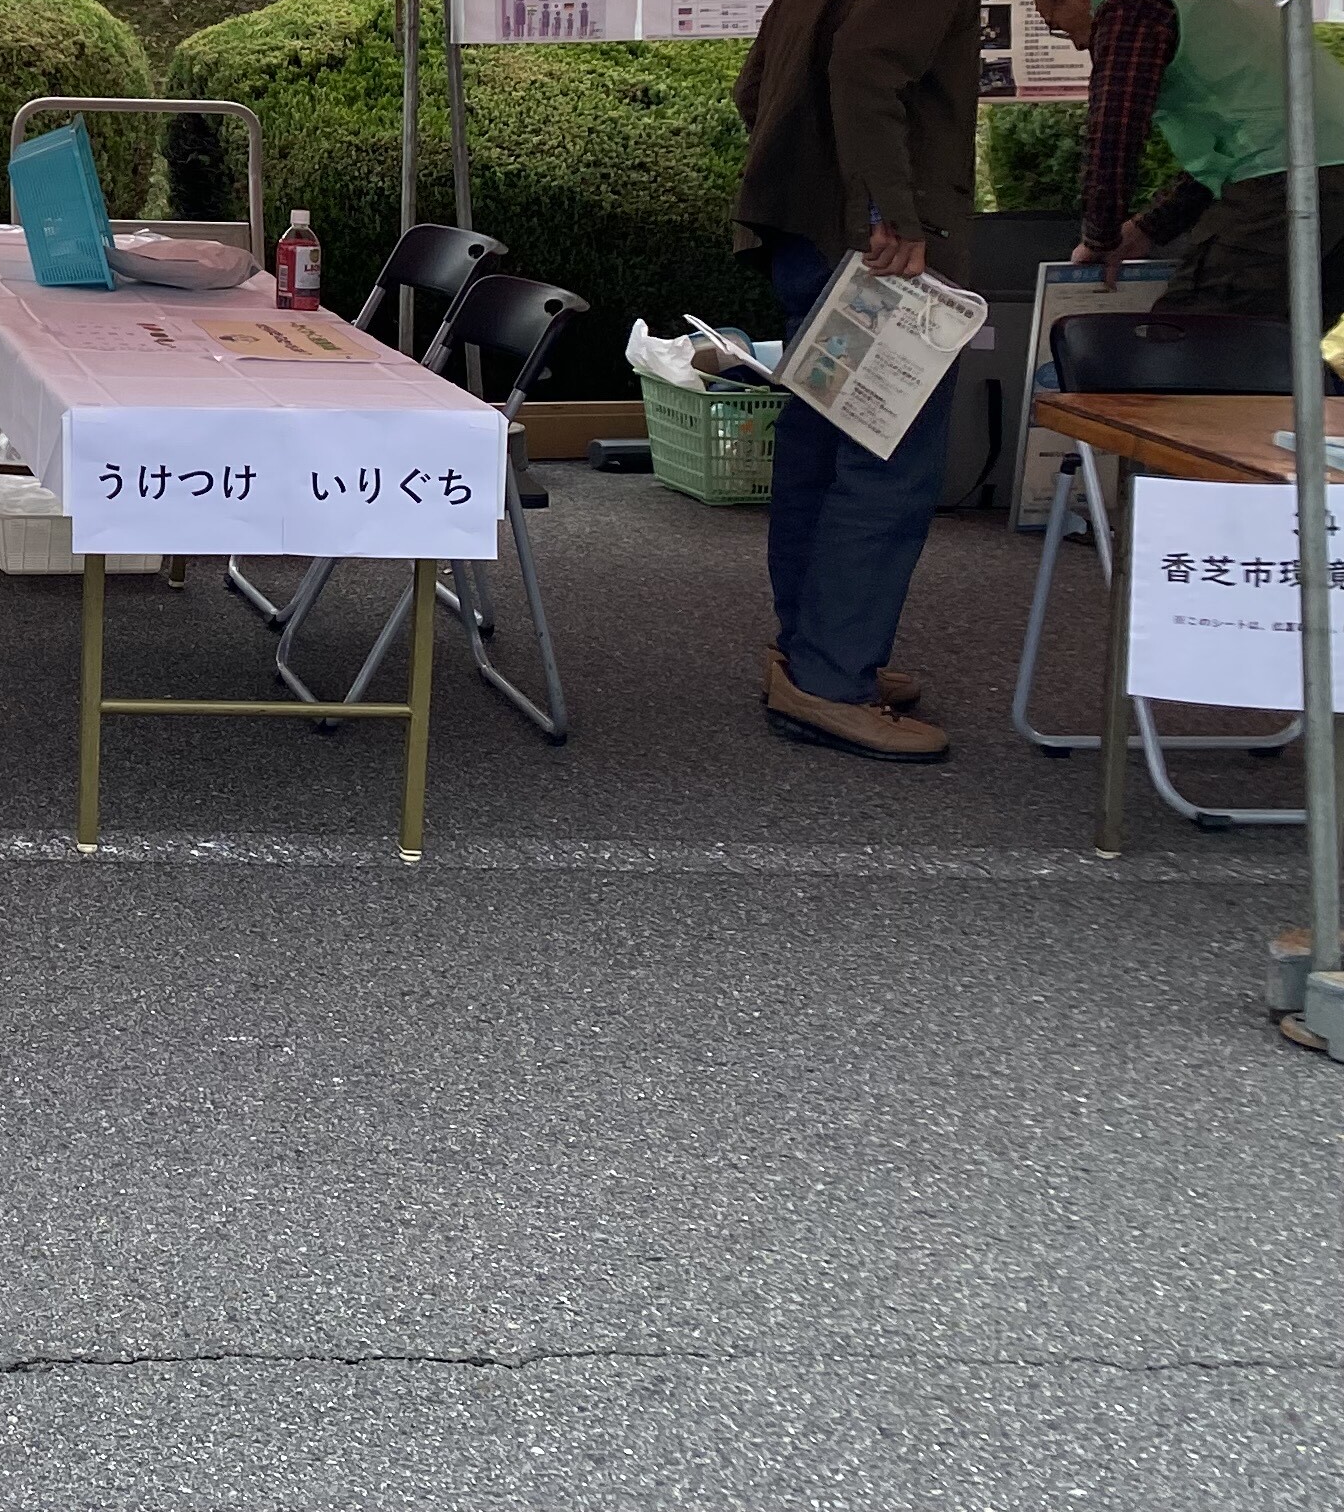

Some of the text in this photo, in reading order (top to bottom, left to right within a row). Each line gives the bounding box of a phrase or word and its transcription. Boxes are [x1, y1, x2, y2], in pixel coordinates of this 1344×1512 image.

[97, 462, 474, 507] うけつけ いりぐち
